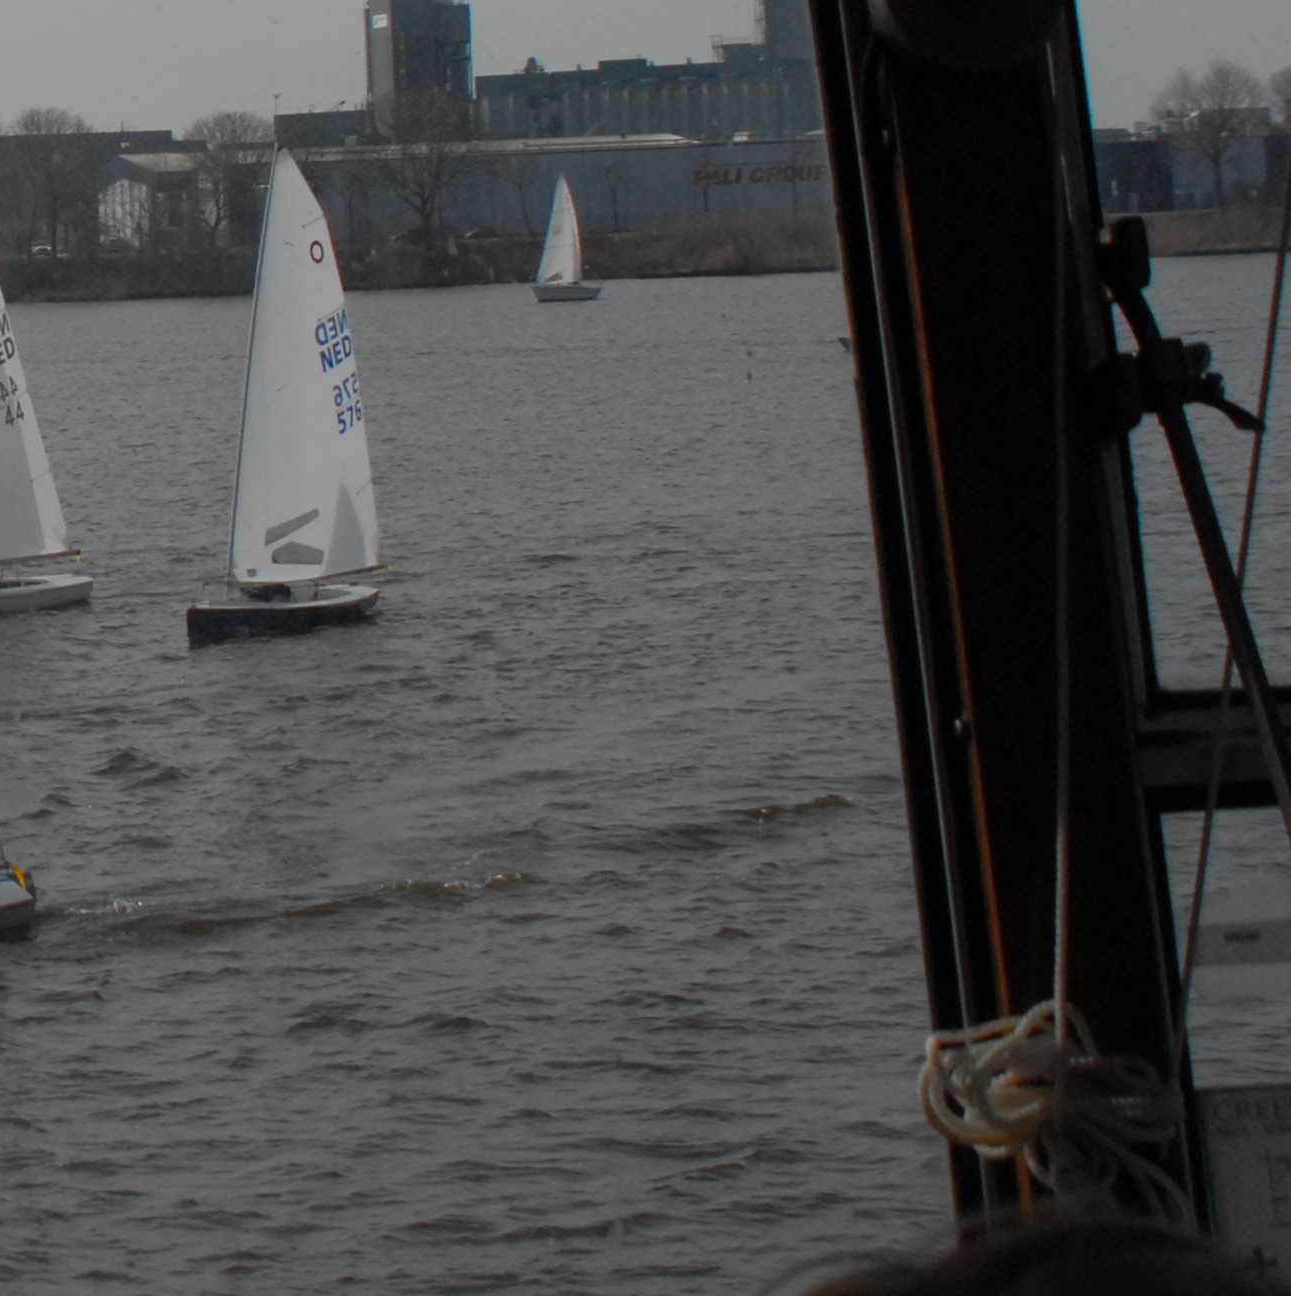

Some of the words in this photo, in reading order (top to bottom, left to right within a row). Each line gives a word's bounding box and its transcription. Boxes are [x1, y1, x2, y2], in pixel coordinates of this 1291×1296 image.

[319, 335, 352, 373] NED
[5, 400, 25, 426] 44
[337, 399, 362, 434] 576
